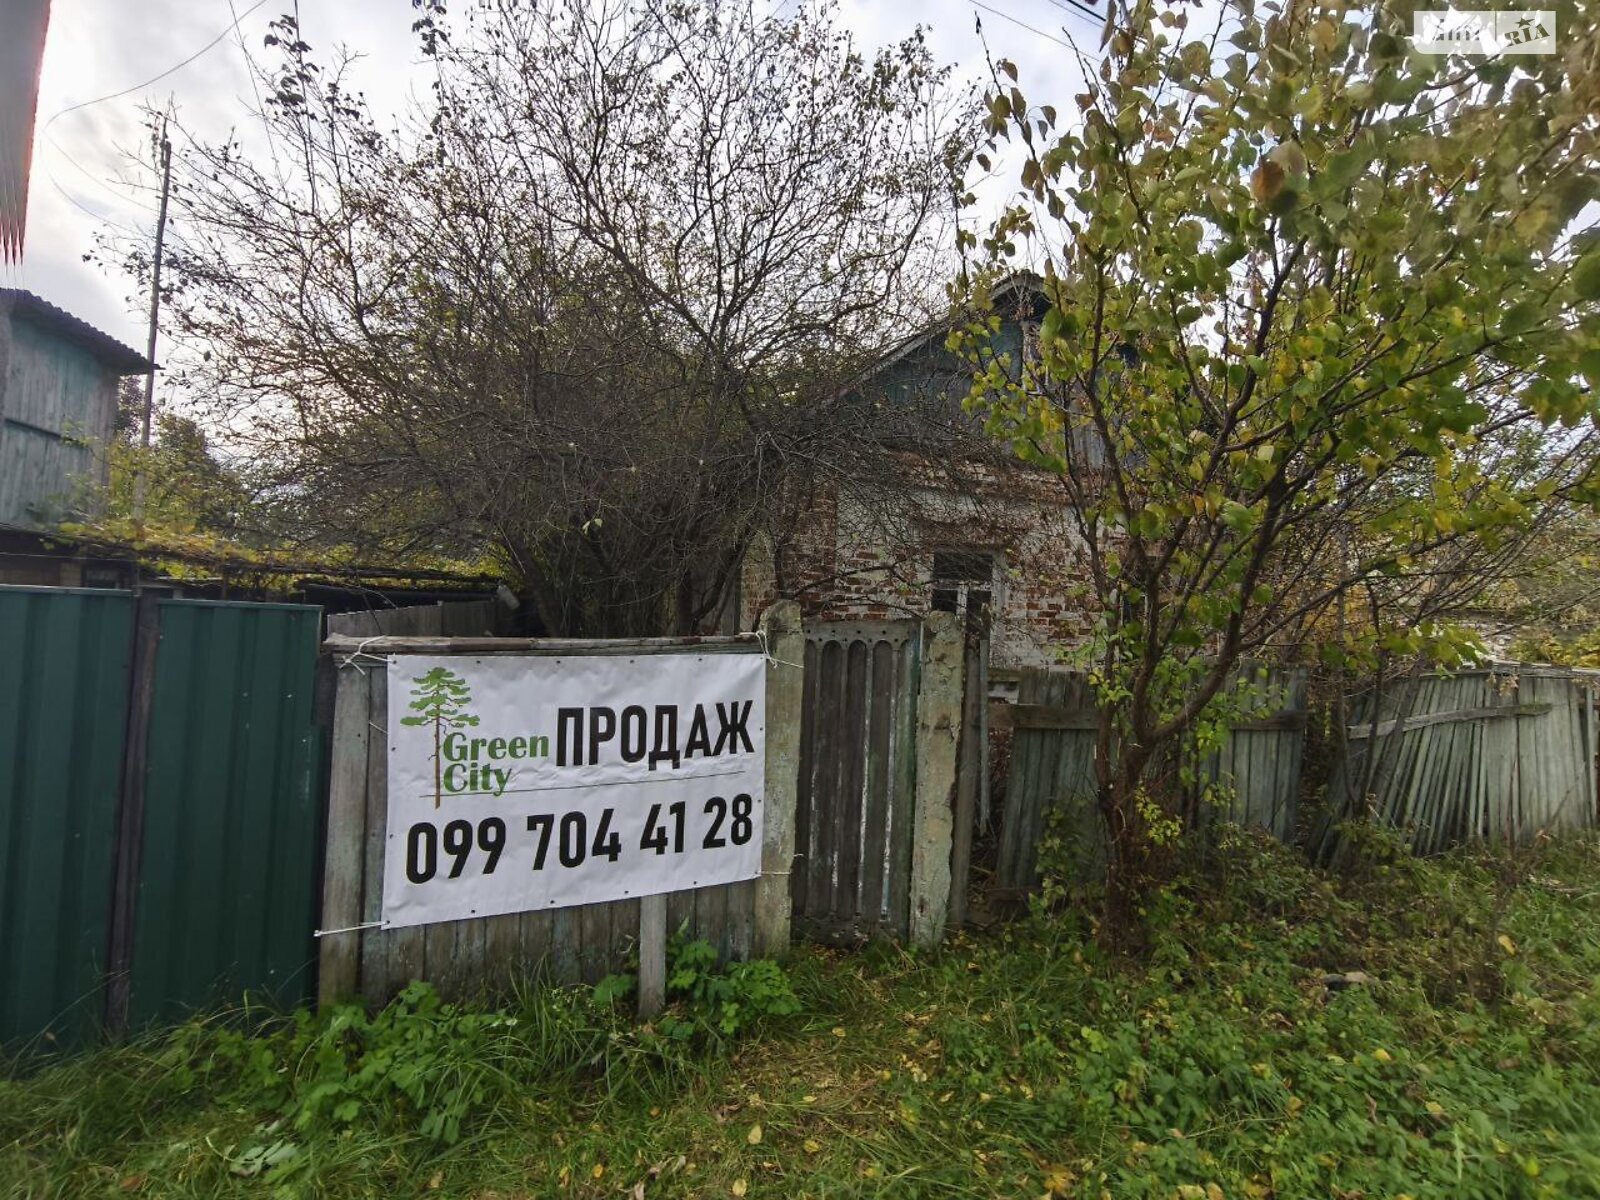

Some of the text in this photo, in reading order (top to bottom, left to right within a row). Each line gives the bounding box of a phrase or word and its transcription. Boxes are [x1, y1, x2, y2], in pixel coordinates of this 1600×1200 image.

[443, 732, 549, 762] Green
[556, 700, 755, 771] ПРОДАЖ
[443, 763, 513, 797] City
[405, 793, 753, 885] 099 704 41 28
